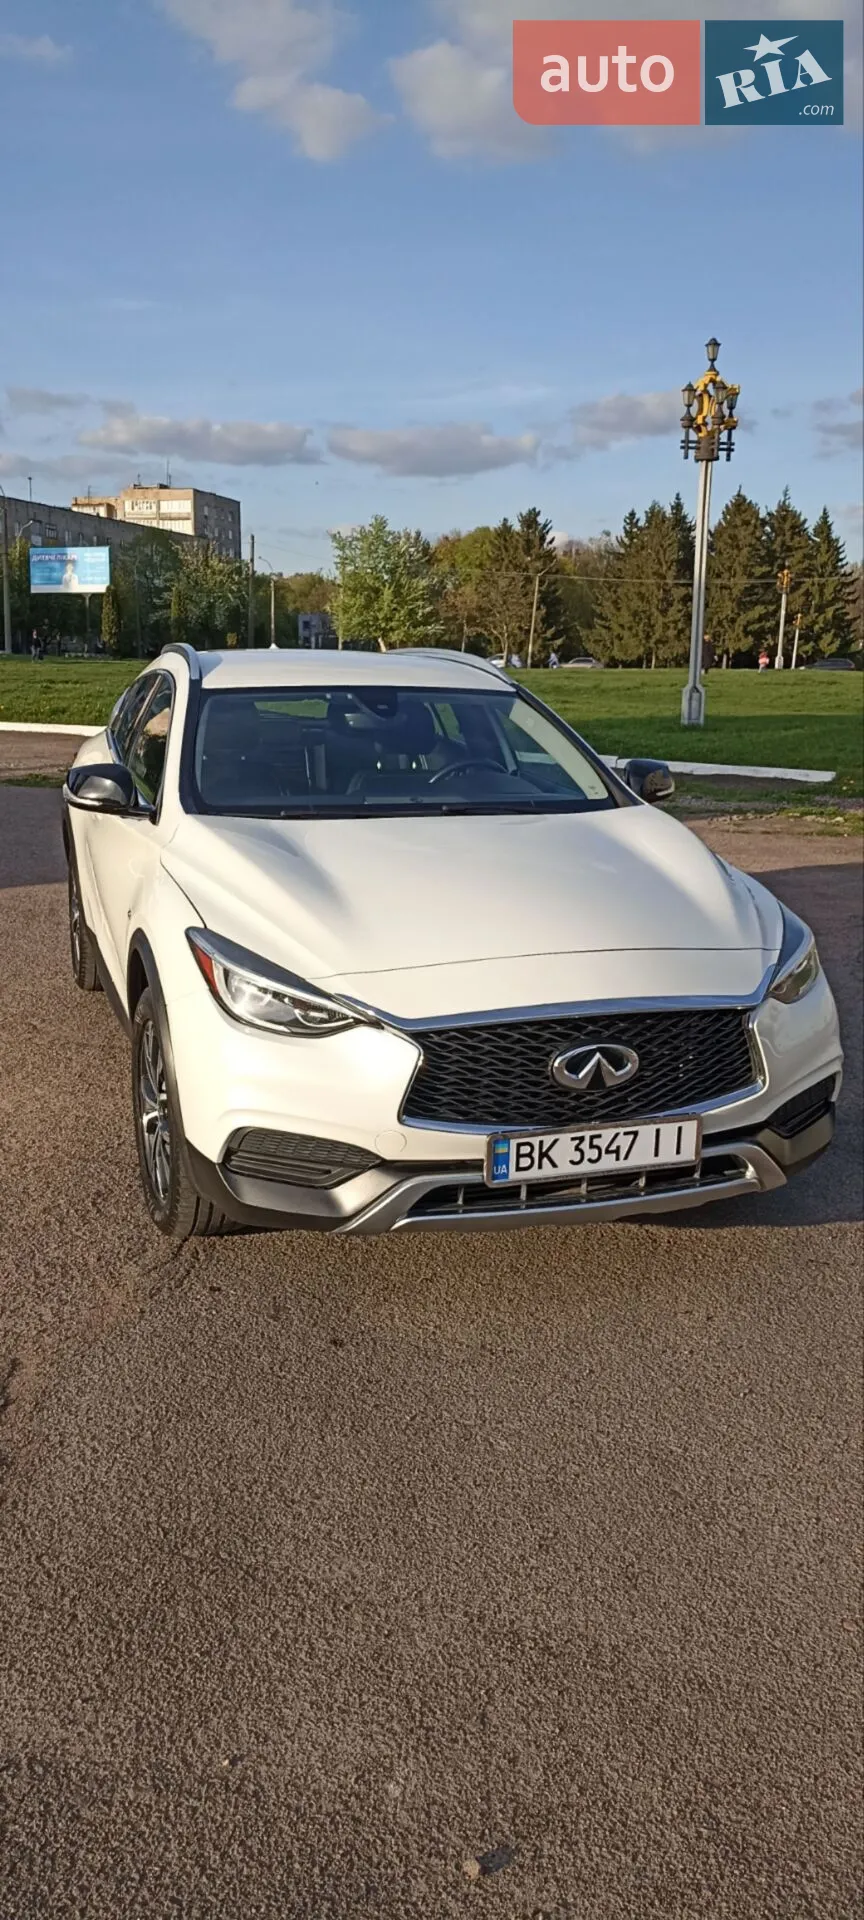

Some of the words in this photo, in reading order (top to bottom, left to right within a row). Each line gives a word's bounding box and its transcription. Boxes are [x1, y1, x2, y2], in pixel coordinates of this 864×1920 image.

[515, 1138, 560, 1172] BK
[569, 1131, 639, 1165] 3547
[493, 1165, 508, 1175] UA
